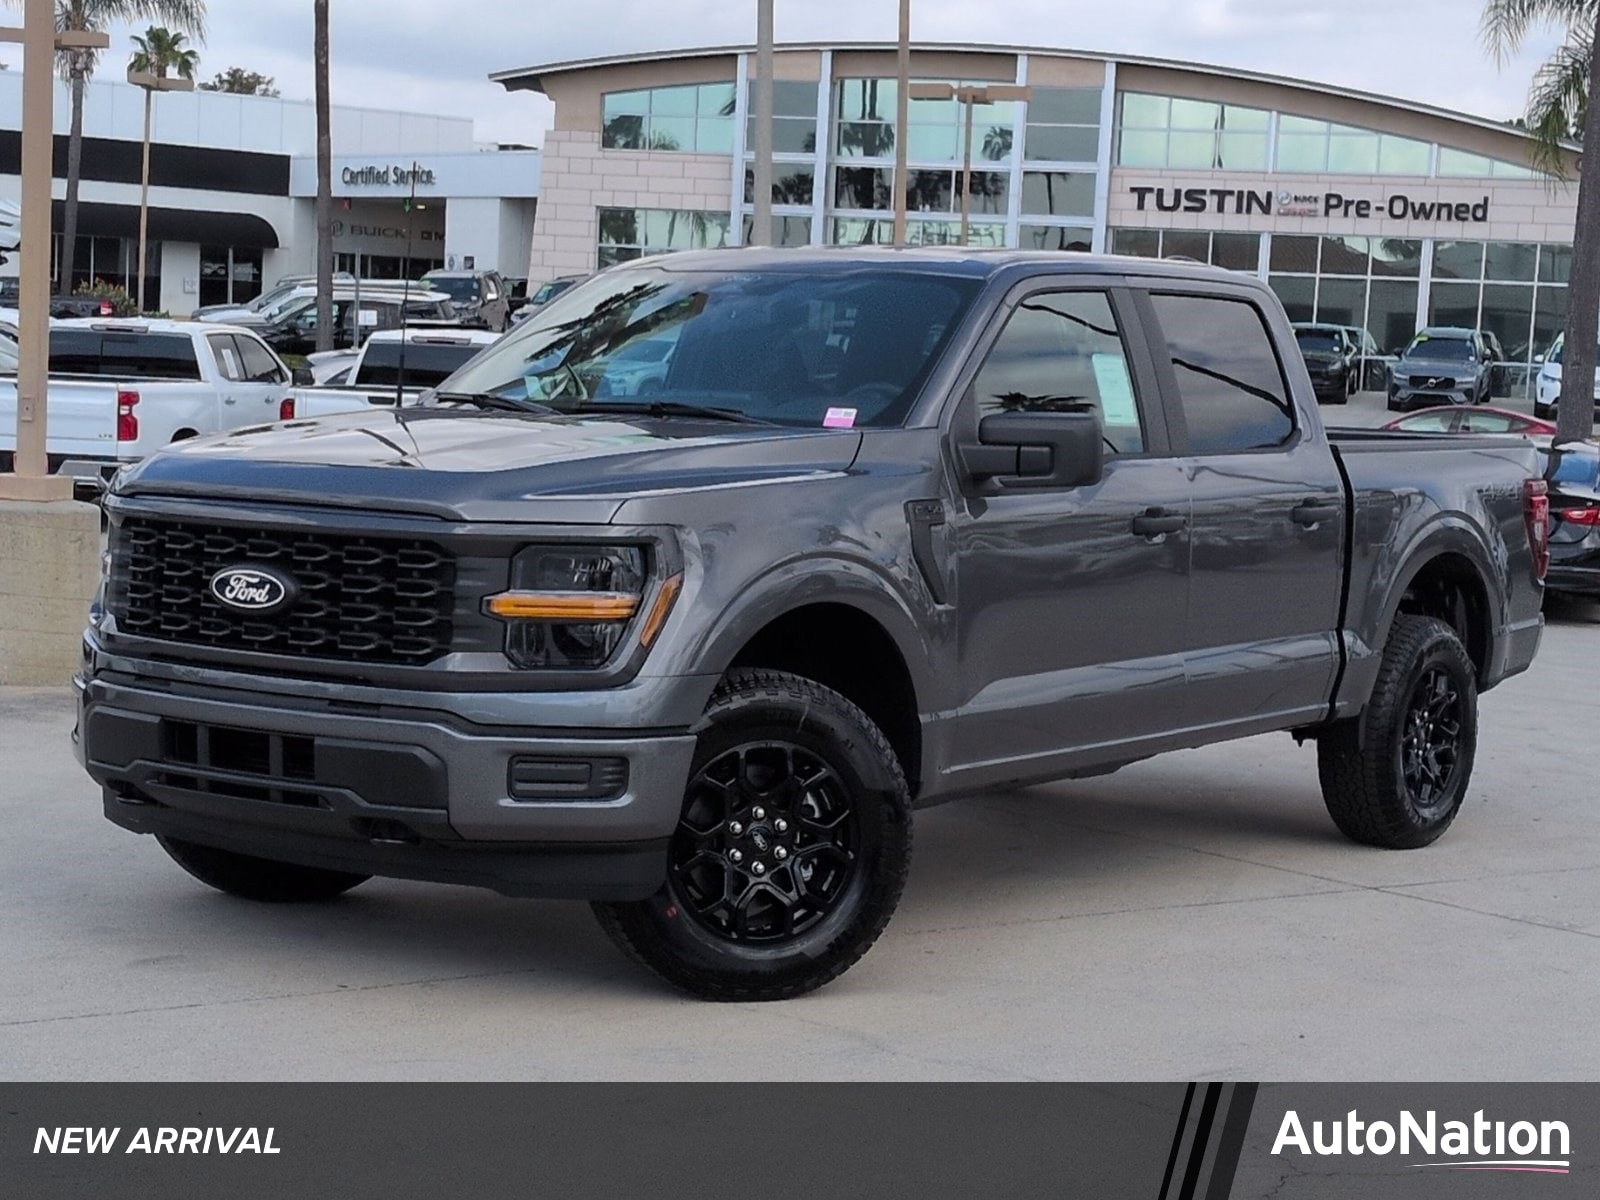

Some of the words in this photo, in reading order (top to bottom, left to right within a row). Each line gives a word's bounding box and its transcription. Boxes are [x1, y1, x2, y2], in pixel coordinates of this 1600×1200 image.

[342, 165, 390, 185] Certified
[392, 165, 433, 186] Service
[1129, 186, 1273, 215] TUSTIN
[1324, 193, 1489, 222] Pre-Owned
[350, 225, 406, 239] BUICK
[225, 574, 271, 602] Ford
